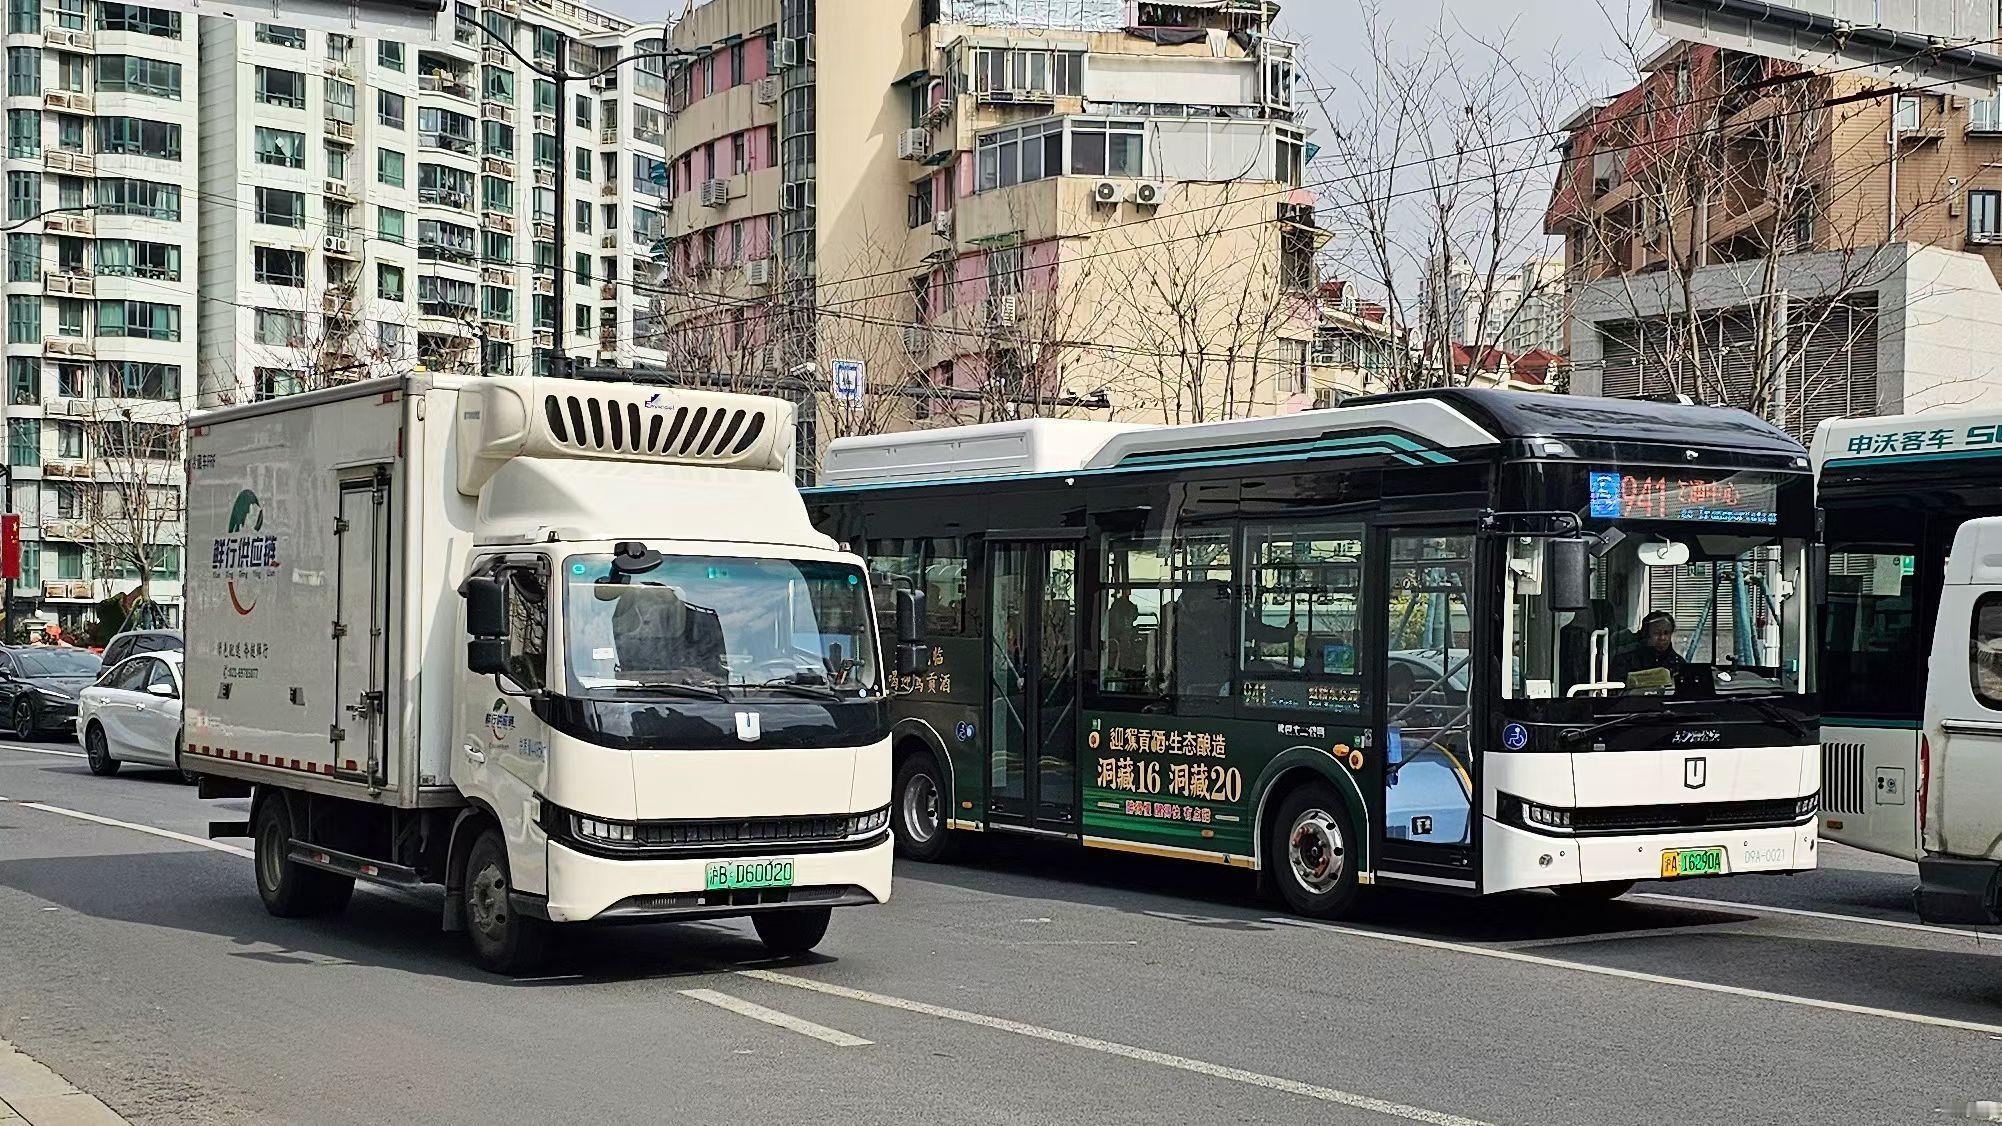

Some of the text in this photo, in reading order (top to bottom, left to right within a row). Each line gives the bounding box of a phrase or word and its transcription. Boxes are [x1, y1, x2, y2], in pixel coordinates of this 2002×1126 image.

[1847, 428, 1954, 454] 申沃客车
[1965, 424, 2002, 446] S
[1621, 475, 1667, 518] 941
[212, 535, 279, 569] 鲜行供应链
[1097, 757, 1242, 803] 洞藏16 洞藏20
[709, 862, 792, 885] 沪B D60020
